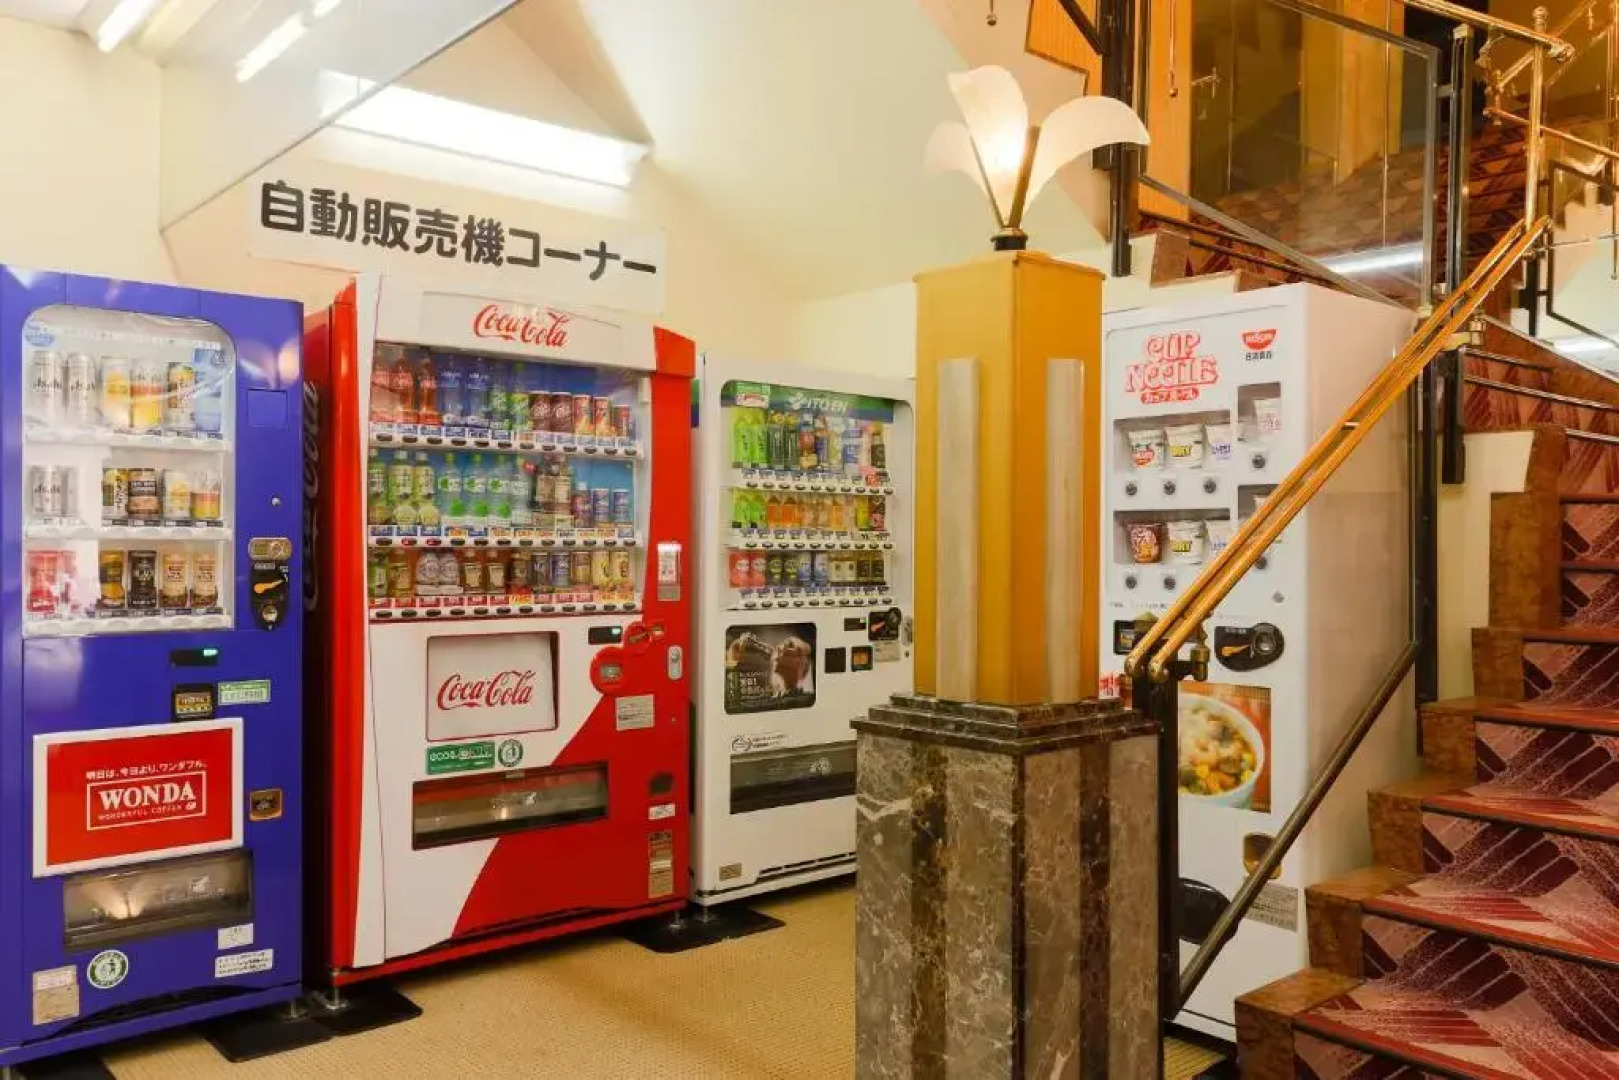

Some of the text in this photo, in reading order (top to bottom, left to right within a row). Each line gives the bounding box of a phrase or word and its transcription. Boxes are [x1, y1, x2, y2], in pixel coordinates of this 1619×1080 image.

[261, 180, 657, 280] 自動販売機コーナー
[437, 669, 536, 711] Coca-Cola
[98, 781, 196, 810] WONDA
